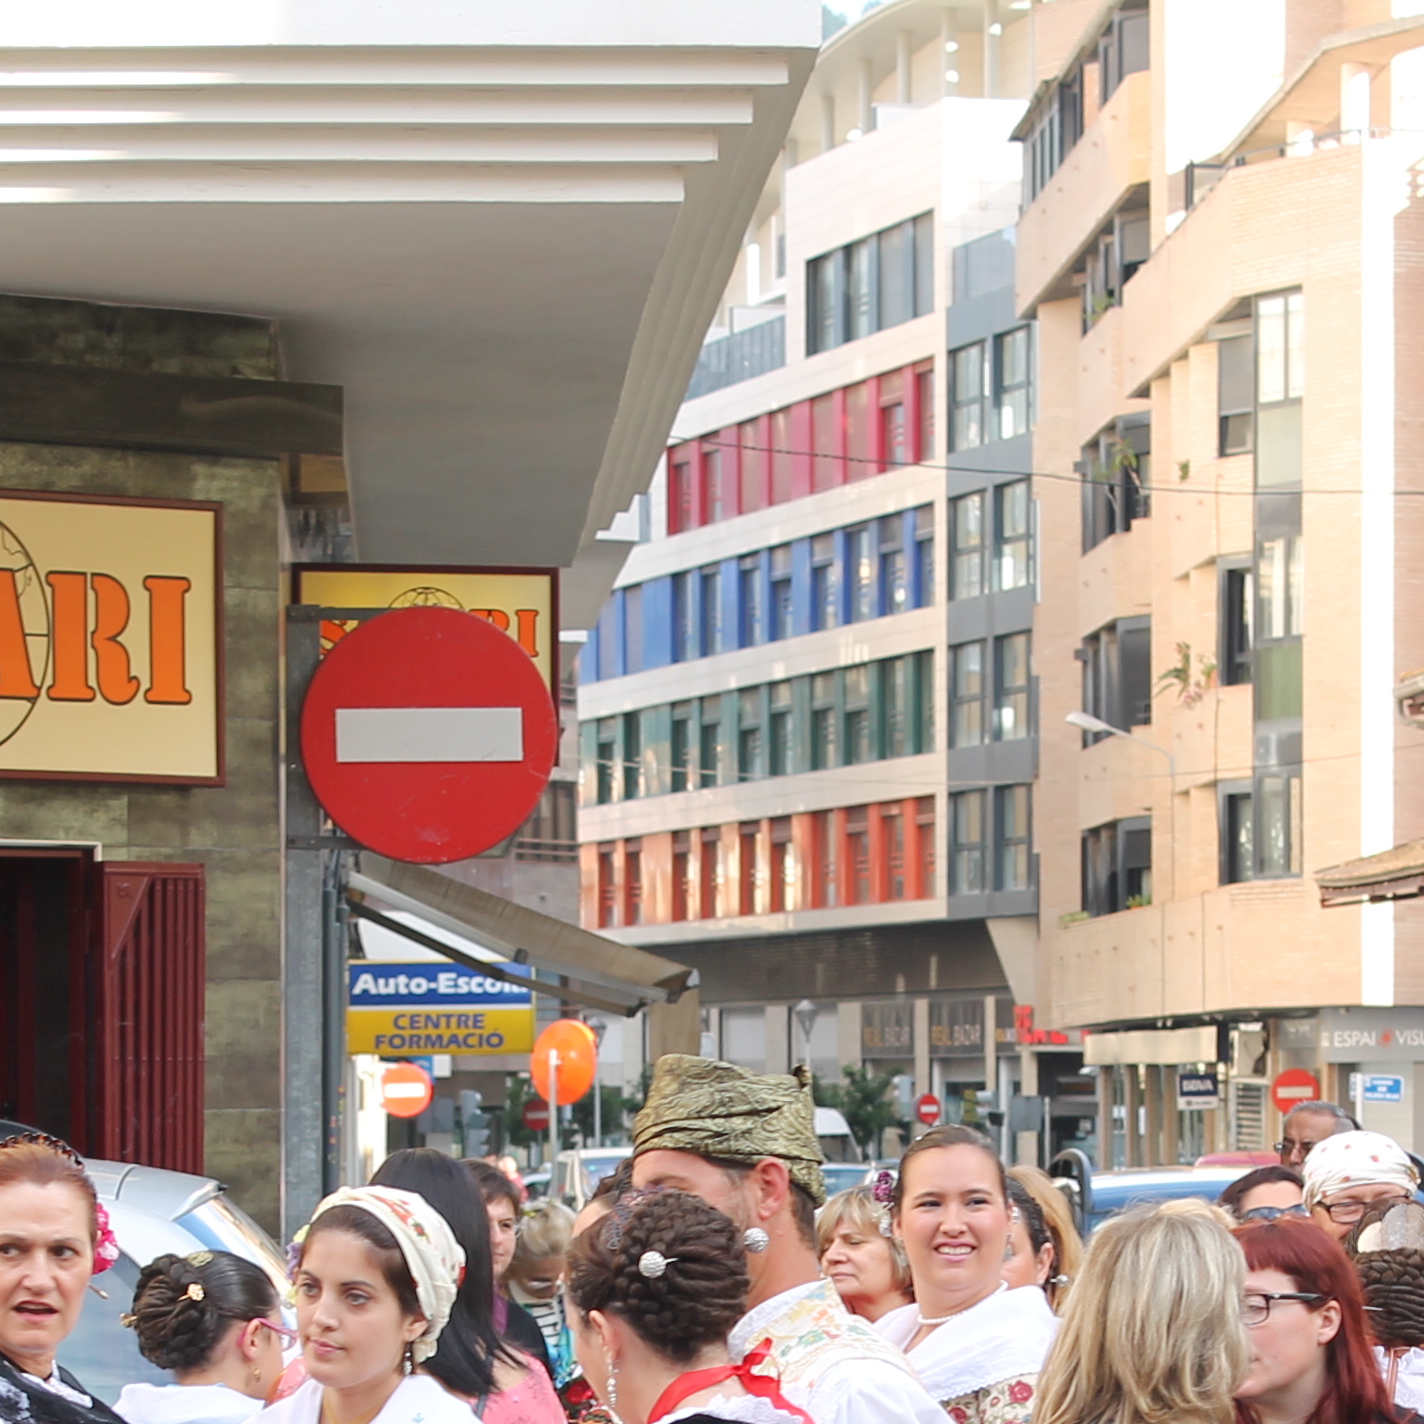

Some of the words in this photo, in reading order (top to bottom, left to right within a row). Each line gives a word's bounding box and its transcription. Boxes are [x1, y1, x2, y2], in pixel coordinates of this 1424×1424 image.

[393, 1014, 485, 1029] CENTRE
[375, 1028, 504, 1049] FORMACIÓ
[1333, 1031, 1375, 1047] ESPAI
